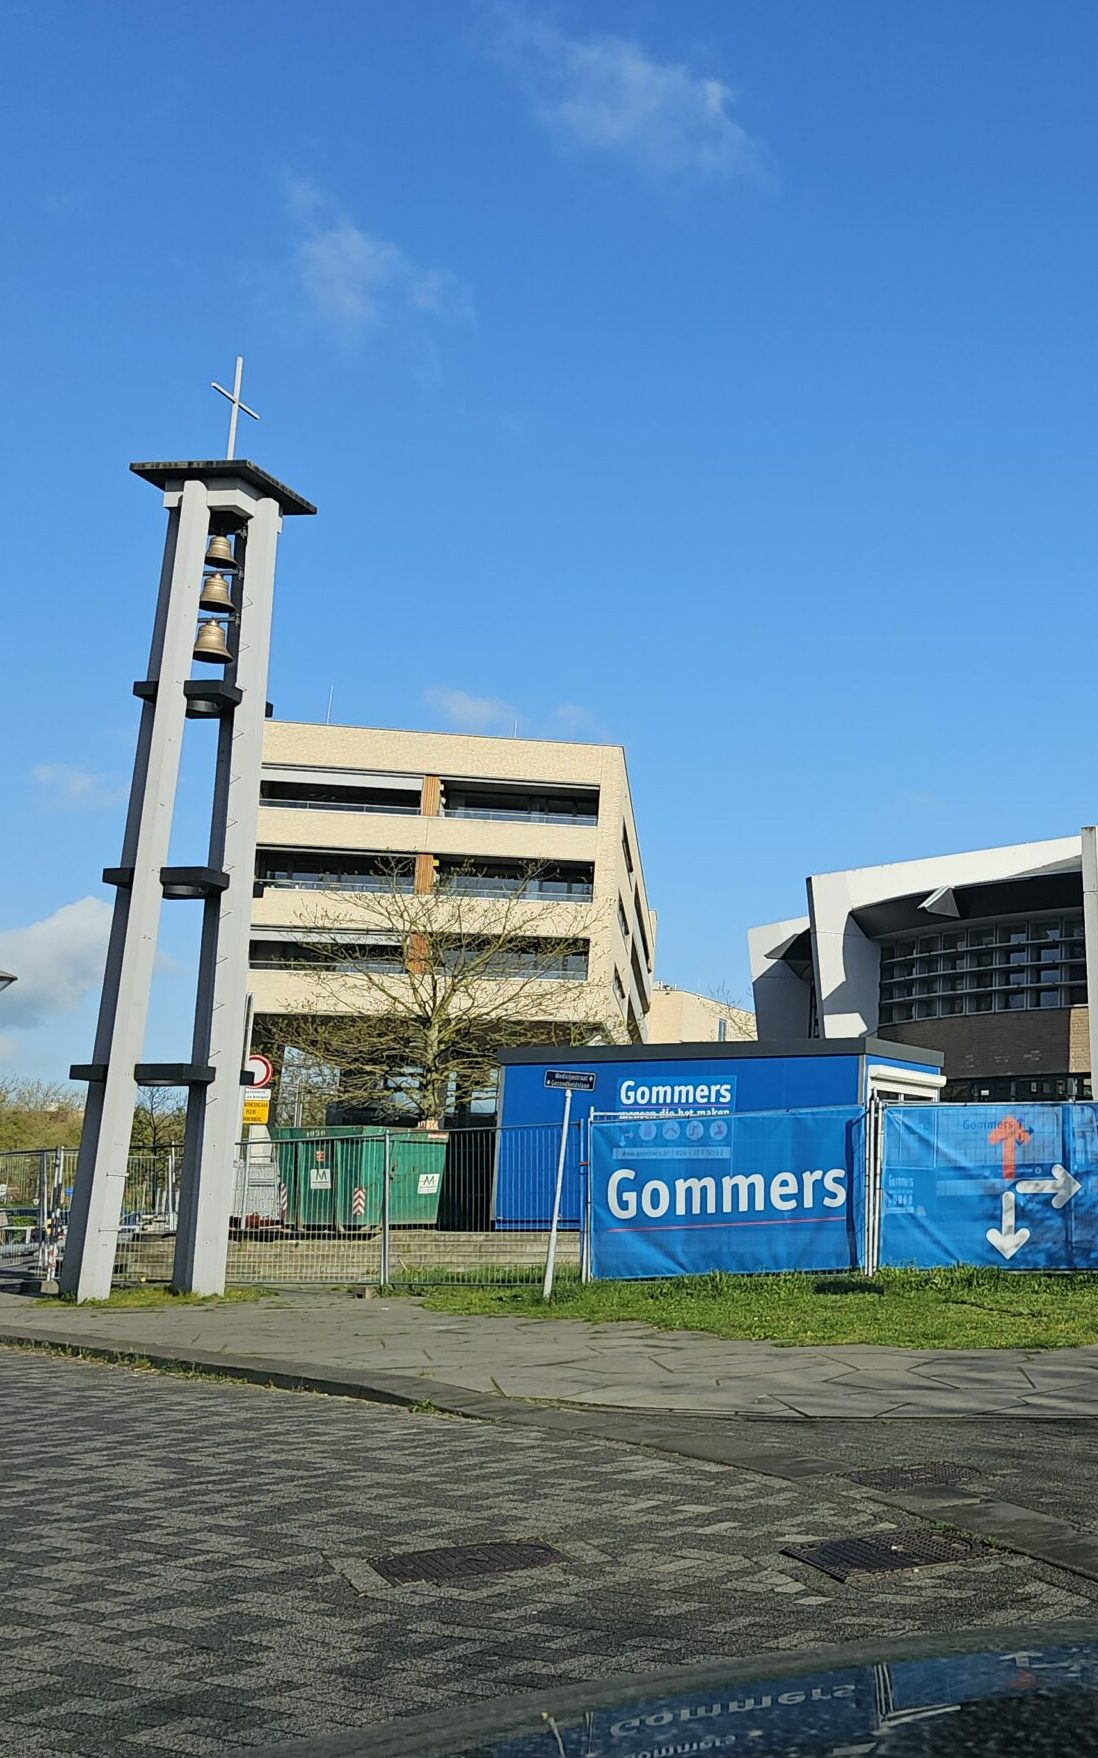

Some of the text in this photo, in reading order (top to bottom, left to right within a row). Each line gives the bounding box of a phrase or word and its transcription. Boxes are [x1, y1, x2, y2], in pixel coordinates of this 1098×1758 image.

[620, 1080, 731, 1105] Gommers
[963, 1119, 1014, 1130] Gommers
[607, 1168, 847, 1220] Gommers
